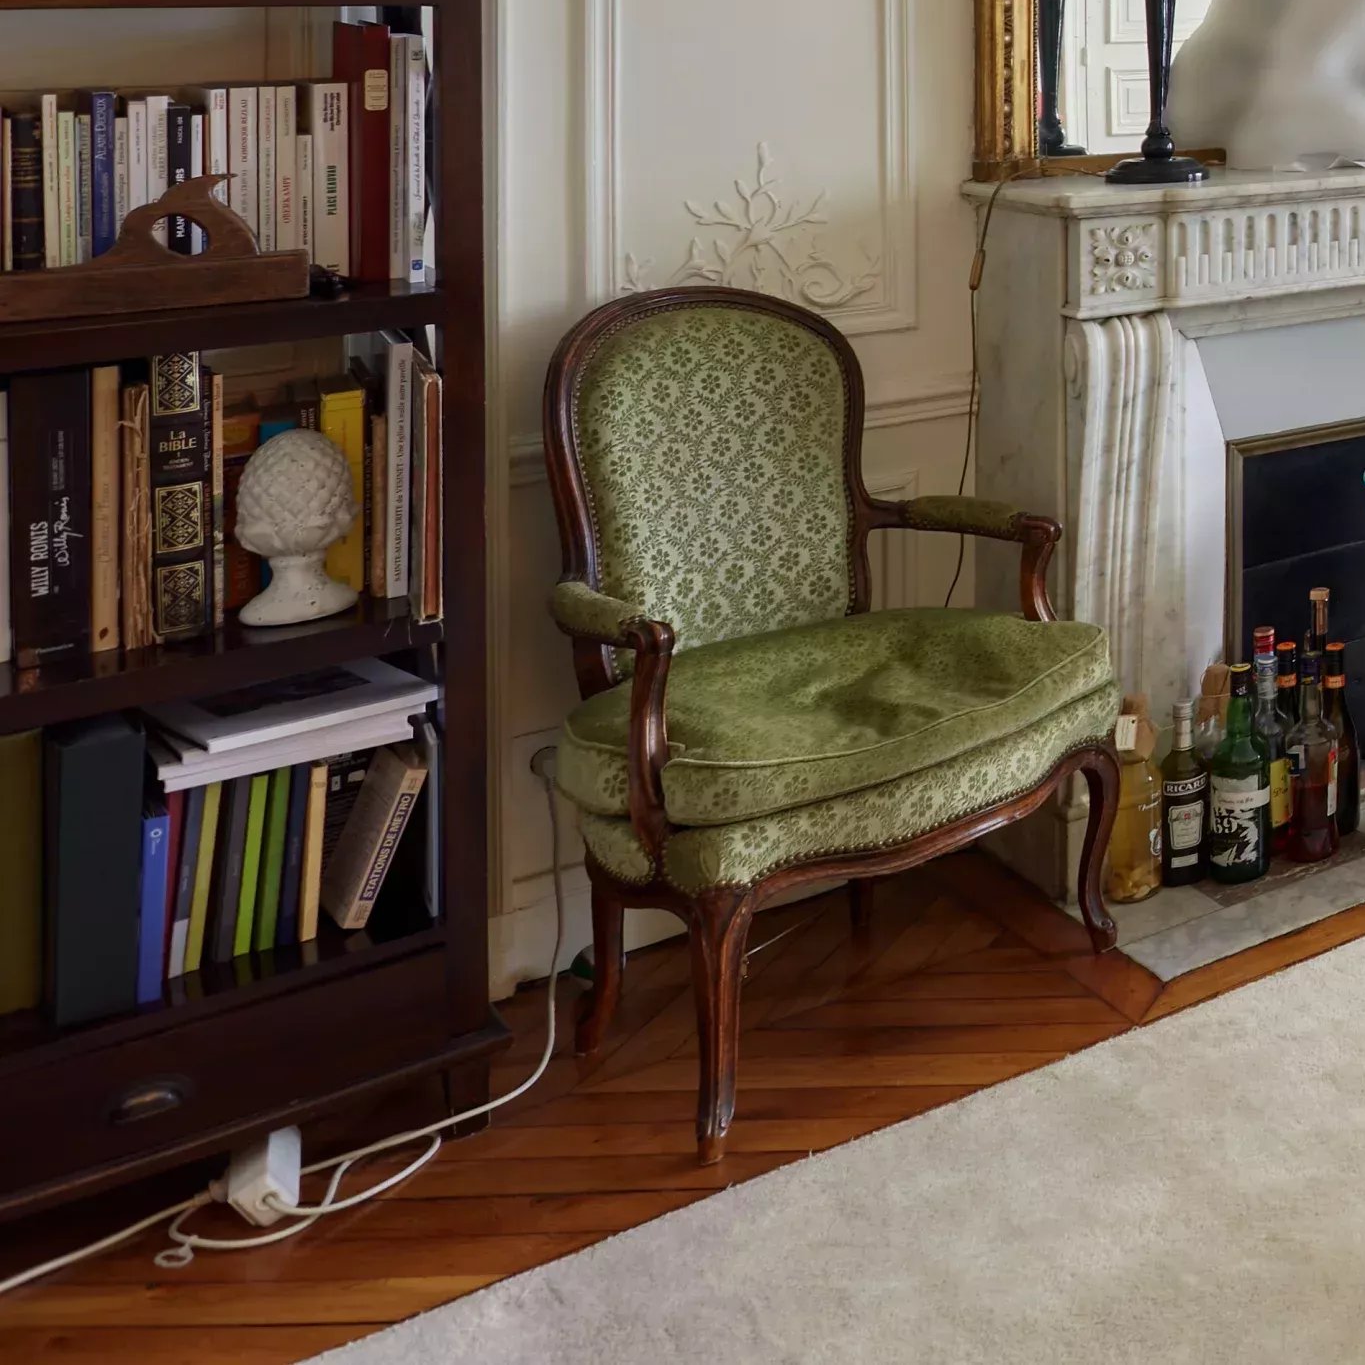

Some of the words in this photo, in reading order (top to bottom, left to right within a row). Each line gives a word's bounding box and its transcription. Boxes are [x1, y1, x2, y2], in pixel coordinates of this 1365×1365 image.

[327, 195, 336, 215] PLACE
[159, 437, 197, 453] BIBLE
[170, 431, 186, 440] La
[30, 521, 49, 561] RONIS
[31, 566, 49, 597] WILLY
[1166, 776, 1206, 793] RICARD
[363, 848, 391, 898] STATIONS
[385, 832, 397, 847] DE
